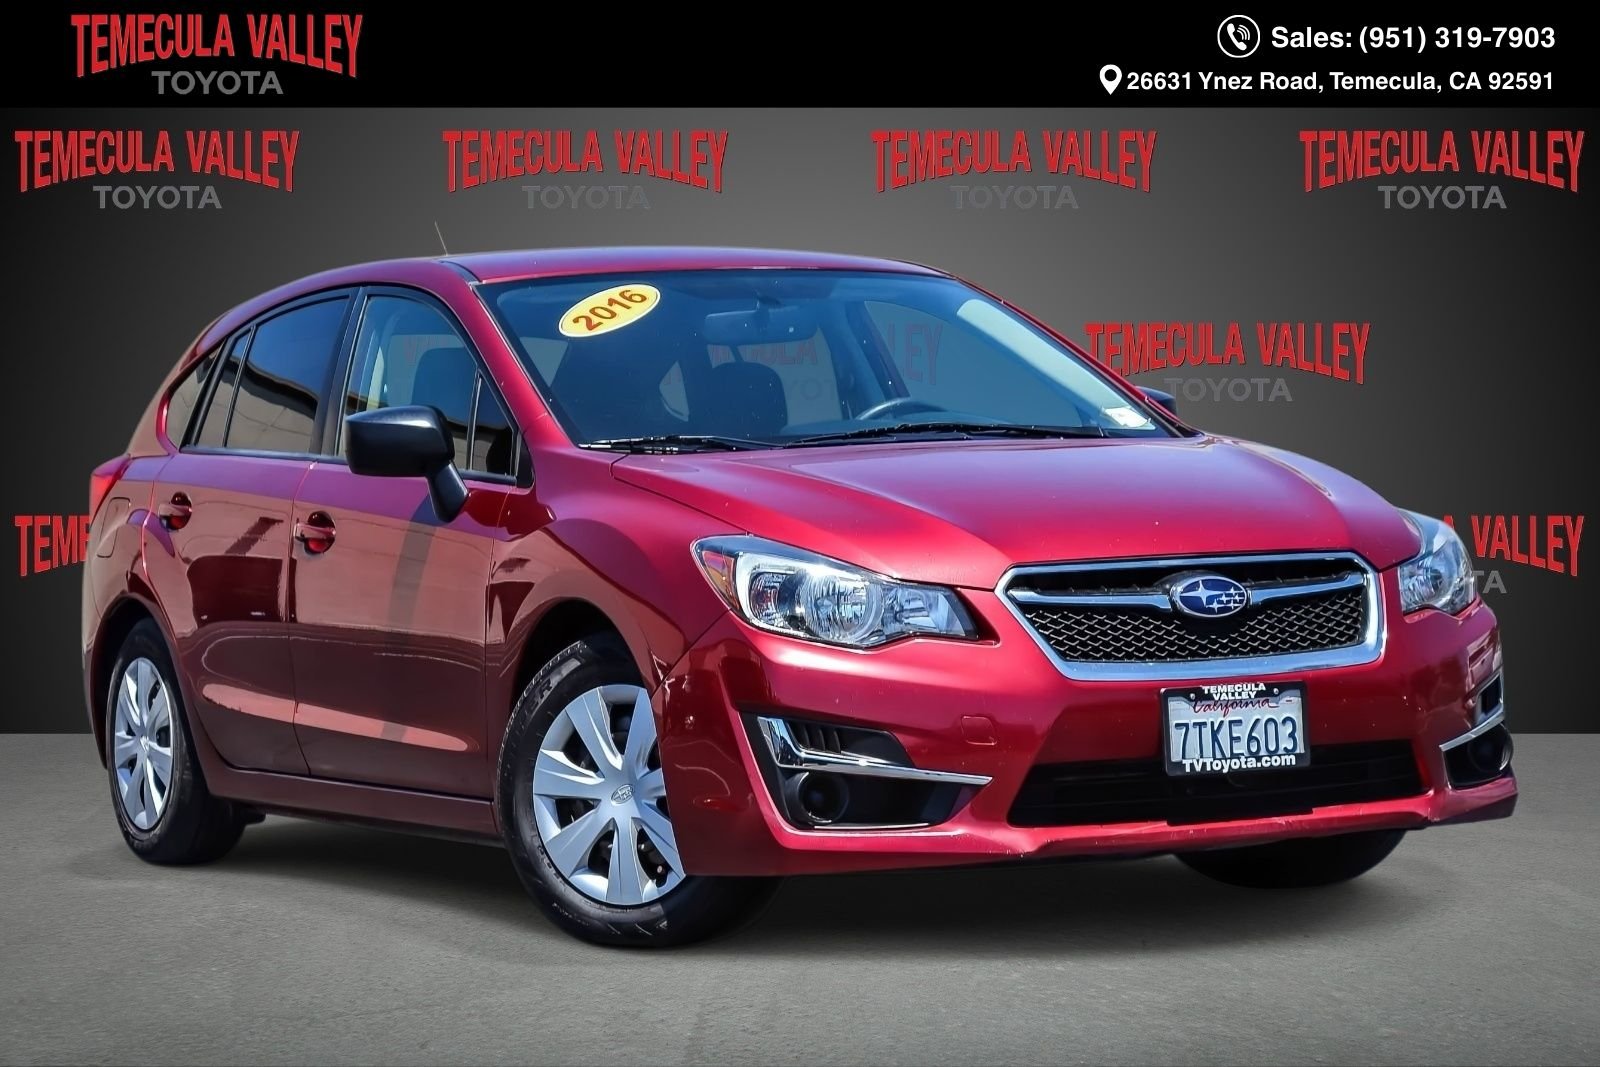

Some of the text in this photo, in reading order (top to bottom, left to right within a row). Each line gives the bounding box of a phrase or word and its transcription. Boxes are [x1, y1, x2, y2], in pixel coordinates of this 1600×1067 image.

[572, 290, 647, 331] 2016
[1202, 682, 1266, 695] TEMECULA
[1213, 691, 1257, 700] VALLEY
[1193, 698, 1279, 717] California
[1174, 716, 1298, 760] 7TKE603
[1182, 754, 1296, 774] TVToyota.com
